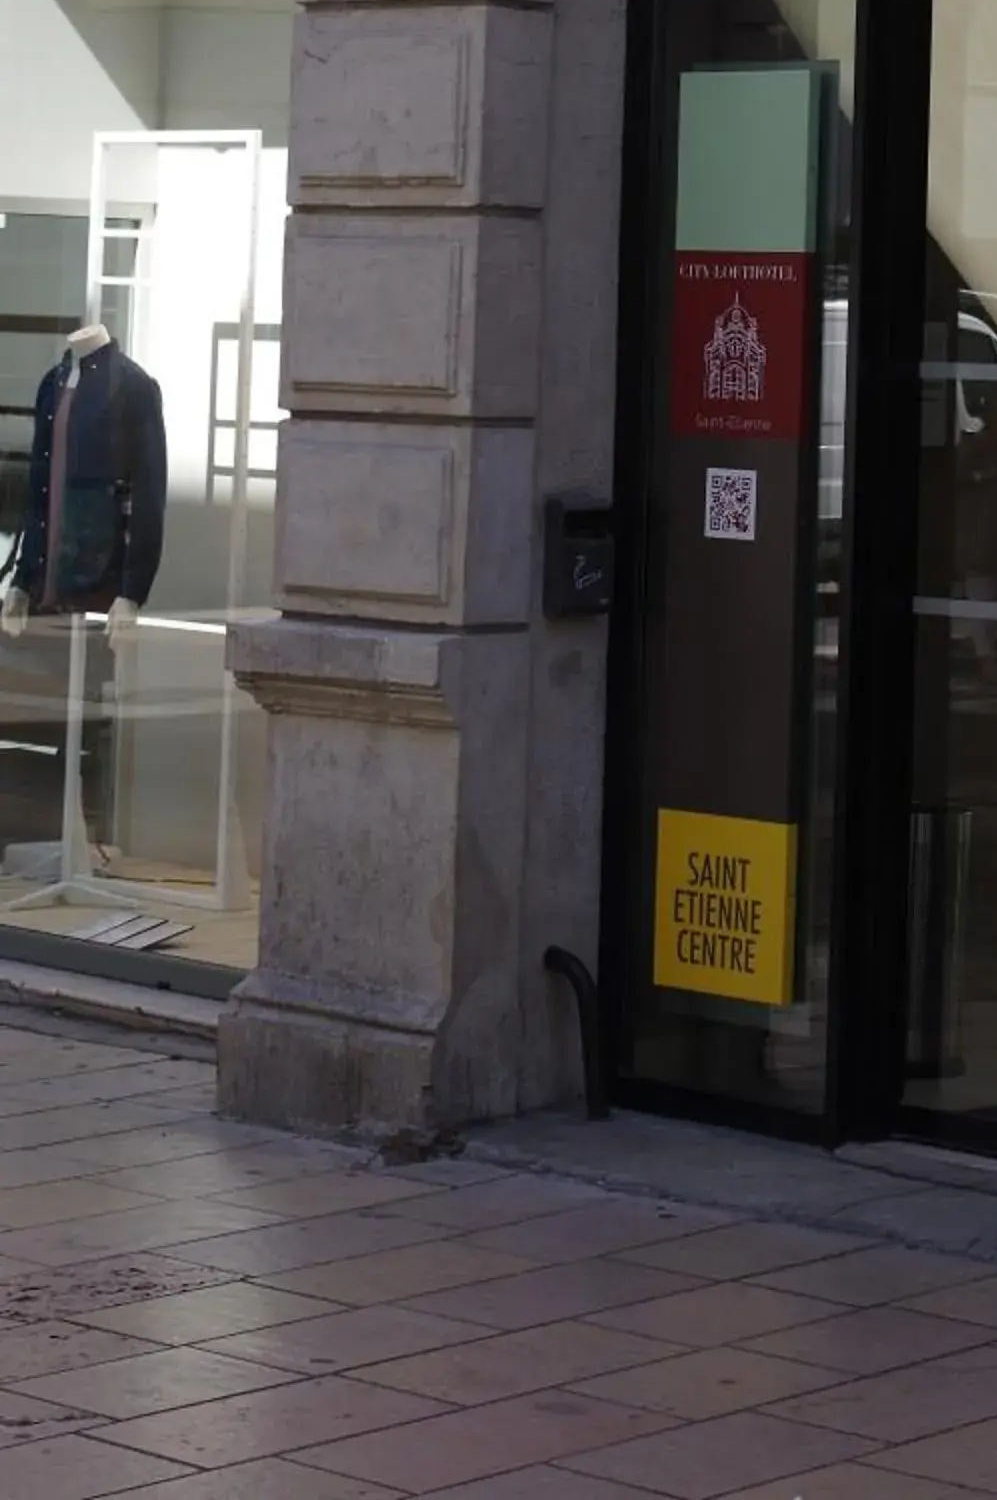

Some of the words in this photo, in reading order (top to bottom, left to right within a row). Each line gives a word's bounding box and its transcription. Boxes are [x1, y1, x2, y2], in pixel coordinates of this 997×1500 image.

[679, 264, 714, 281] CITY
[687, 851, 751, 894] SAINT
[673, 888, 762, 936] ETIENNE
[676, 928, 757, 975] CENTRE
